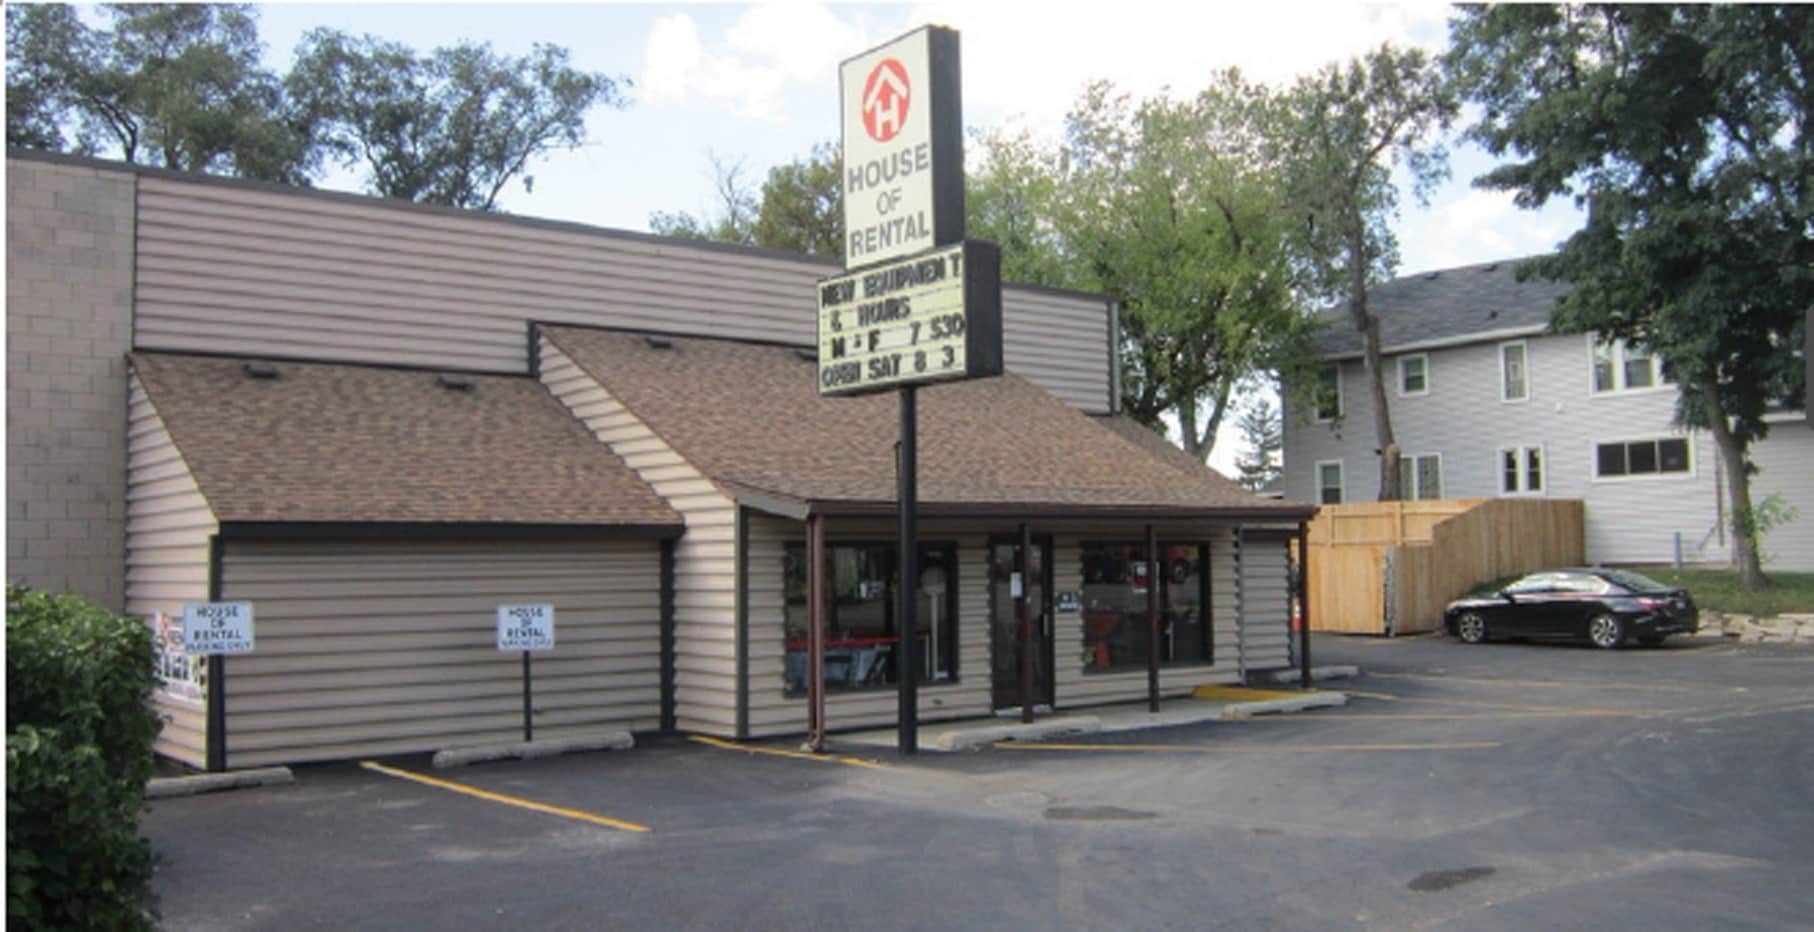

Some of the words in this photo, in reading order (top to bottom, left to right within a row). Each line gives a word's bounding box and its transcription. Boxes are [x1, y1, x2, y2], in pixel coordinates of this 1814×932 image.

[848, 142, 929, 193] HOUSE
[876, 187, 902, 216] OF
[850, 211, 930, 257] RENTAL
[822, 279, 855, 309] NEW
[858, 296, 911, 327] HOURS
[832, 336, 845, 359] M
[868, 329, 881, 352] F
[910, 322, 921, 345] 7
[822, 361, 861, 386] OPEN
[868, 353, 901, 380] SAT
[914, 350, 927, 373] 8
[942, 345, 955, 368] 3
[196, 605, 239, 618] HOUSE
[210, 619, 225, 629] OF
[508, 607, 543, 618] HOUSE
[193, 630, 242, 640] RENTAL
[507, 628, 545, 639] RENTAL
